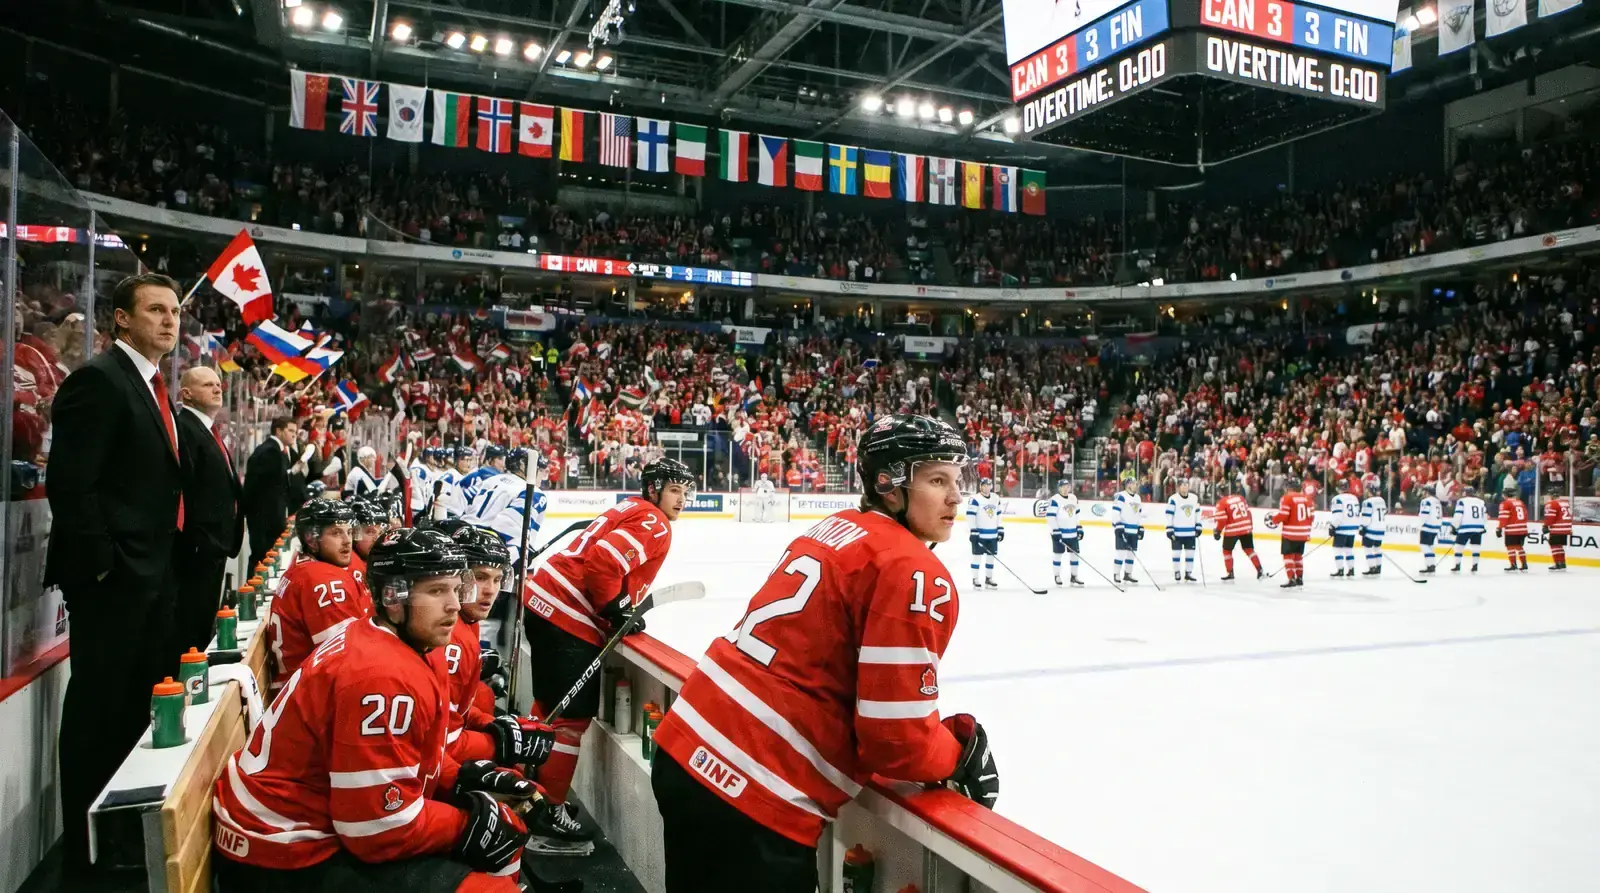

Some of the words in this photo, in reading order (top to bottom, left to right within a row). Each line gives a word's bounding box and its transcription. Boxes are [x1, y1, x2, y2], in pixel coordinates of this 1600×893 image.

[1205, 0, 1254, 31] CAN
[1267, 3, 1282, 36] 3
[1305, 12, 1320, 45] 3
[1334, 18, 1368, 56] FIN
[1012, 54, 1048, 97] CAN
[1056, 44, 1068, 76] 3
[1086, 28, 1099, 62] 3
[1110, 5, 1143, 50] FIN
[1207, 36, 1324, 92] OVERTIME:
[1330, 63, 1378, 103] 0:00
[1024, 68, 1114, 133] OVERTIME:
[1119, 43, 1166, 92] 0:00
[576, 259, 598, 272] CAN
[604, 261, 613, 275] 3
[685, 268, 693, 281] 3
[707, 269, 722, 283] FIN
[641, 513, 669, 539] 27
[314, 580, 346, 608] 25
[909, 570, 951, 623] 12
[362, 693, 415, 736] 20
[704, 758, 741, 789] INF
